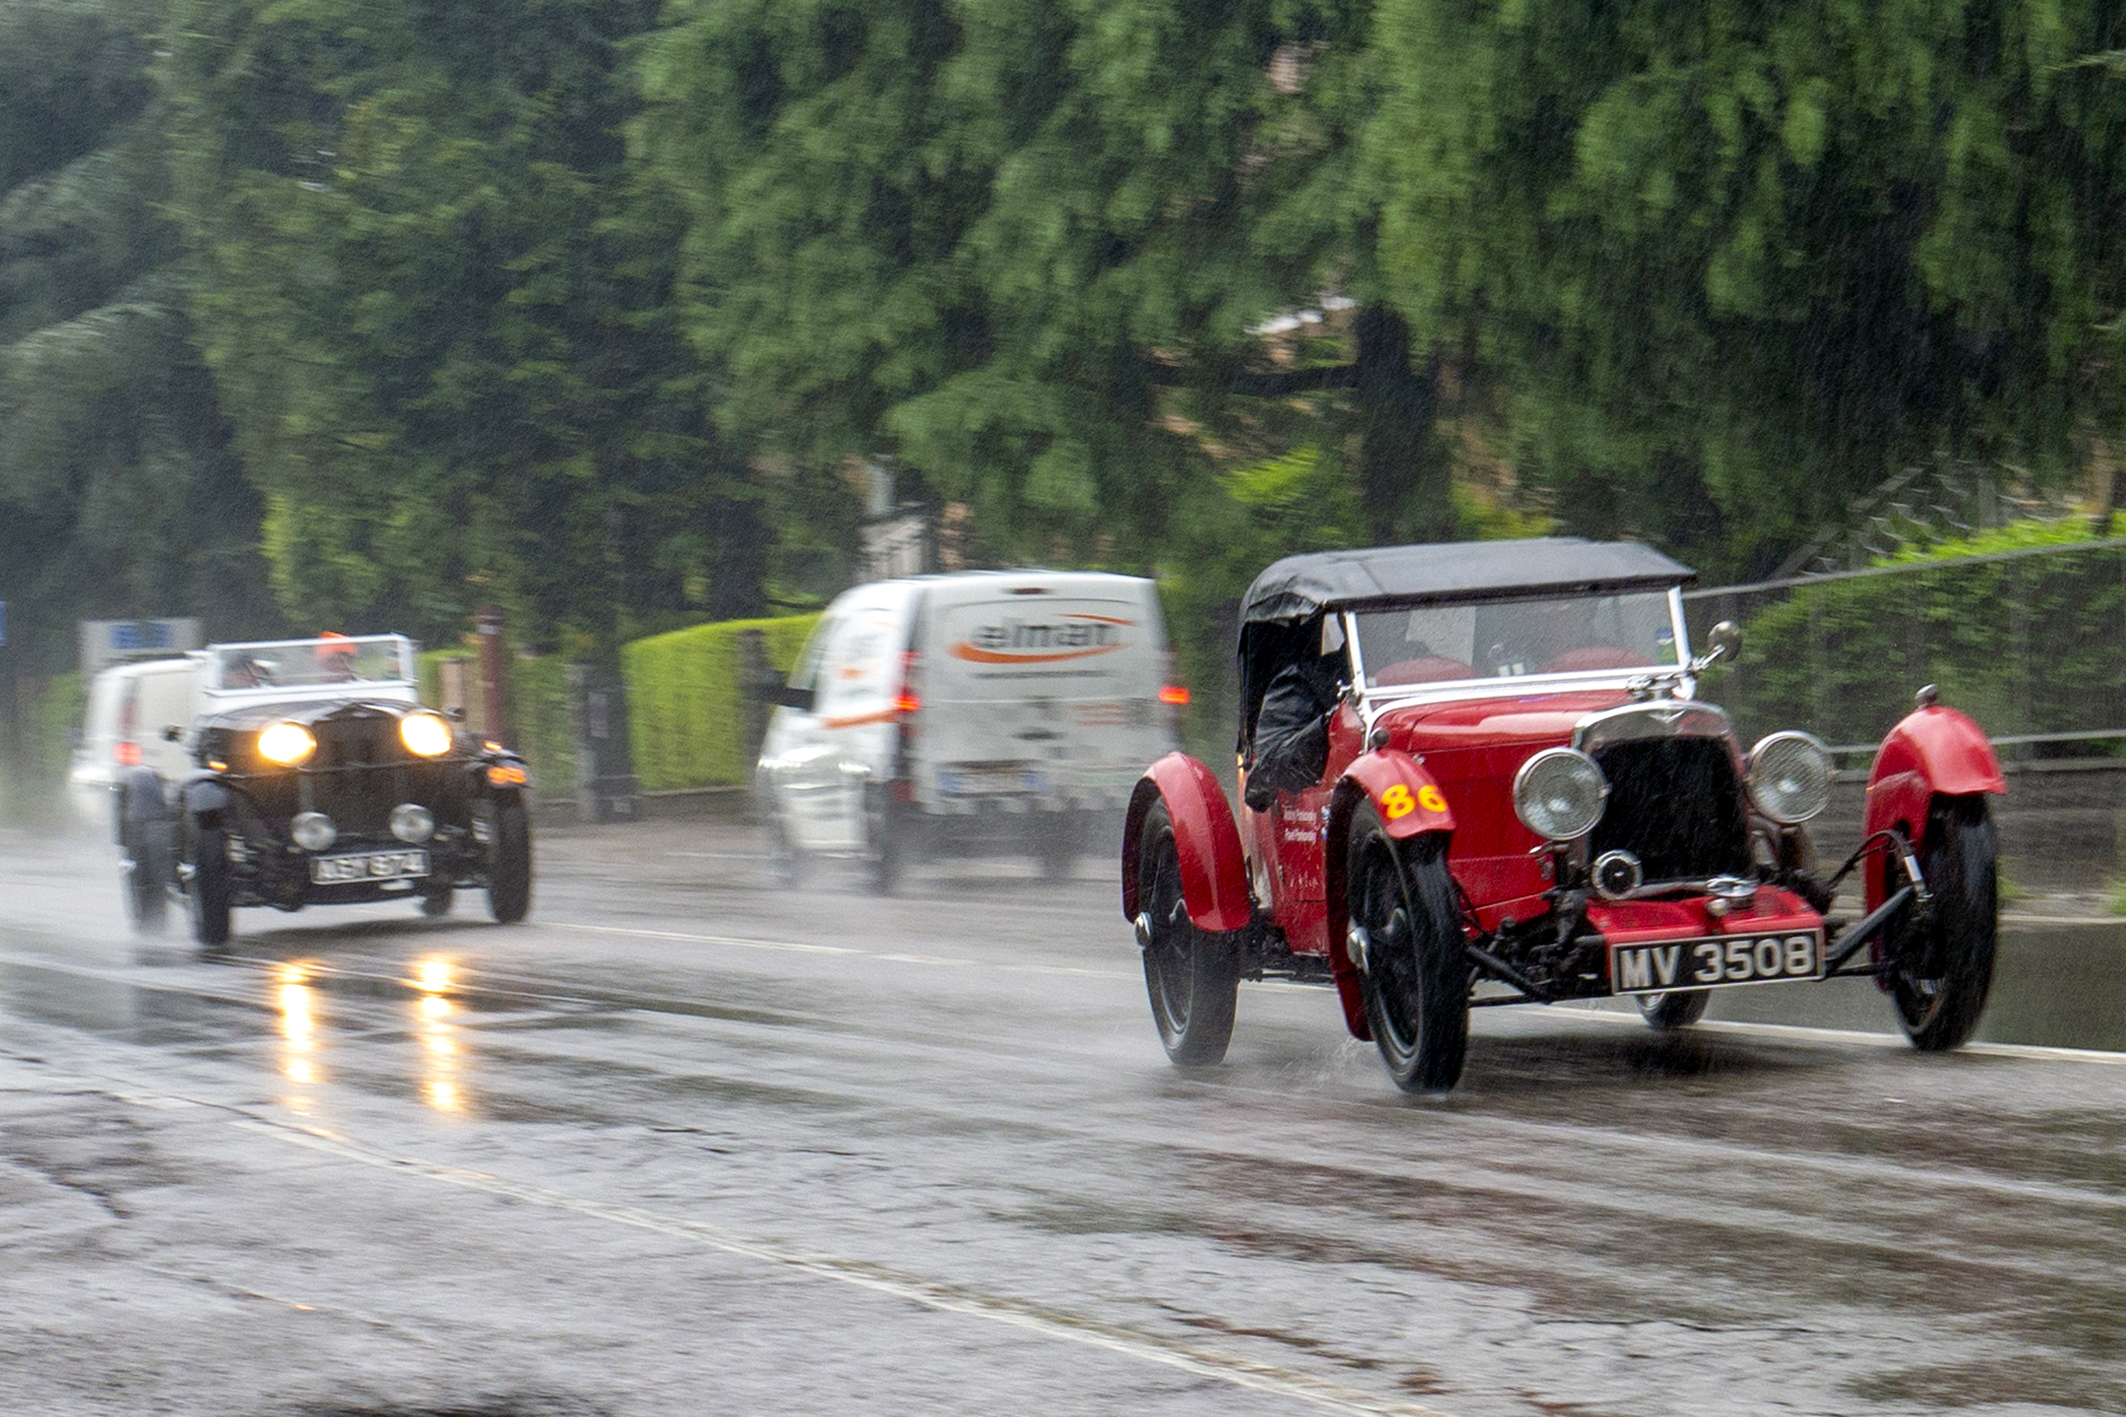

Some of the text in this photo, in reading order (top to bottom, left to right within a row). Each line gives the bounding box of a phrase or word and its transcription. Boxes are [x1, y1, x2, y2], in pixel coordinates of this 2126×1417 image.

[1381, 784, 1448, 819] 86
[1620, 936, 1815, 988] MV 3508
